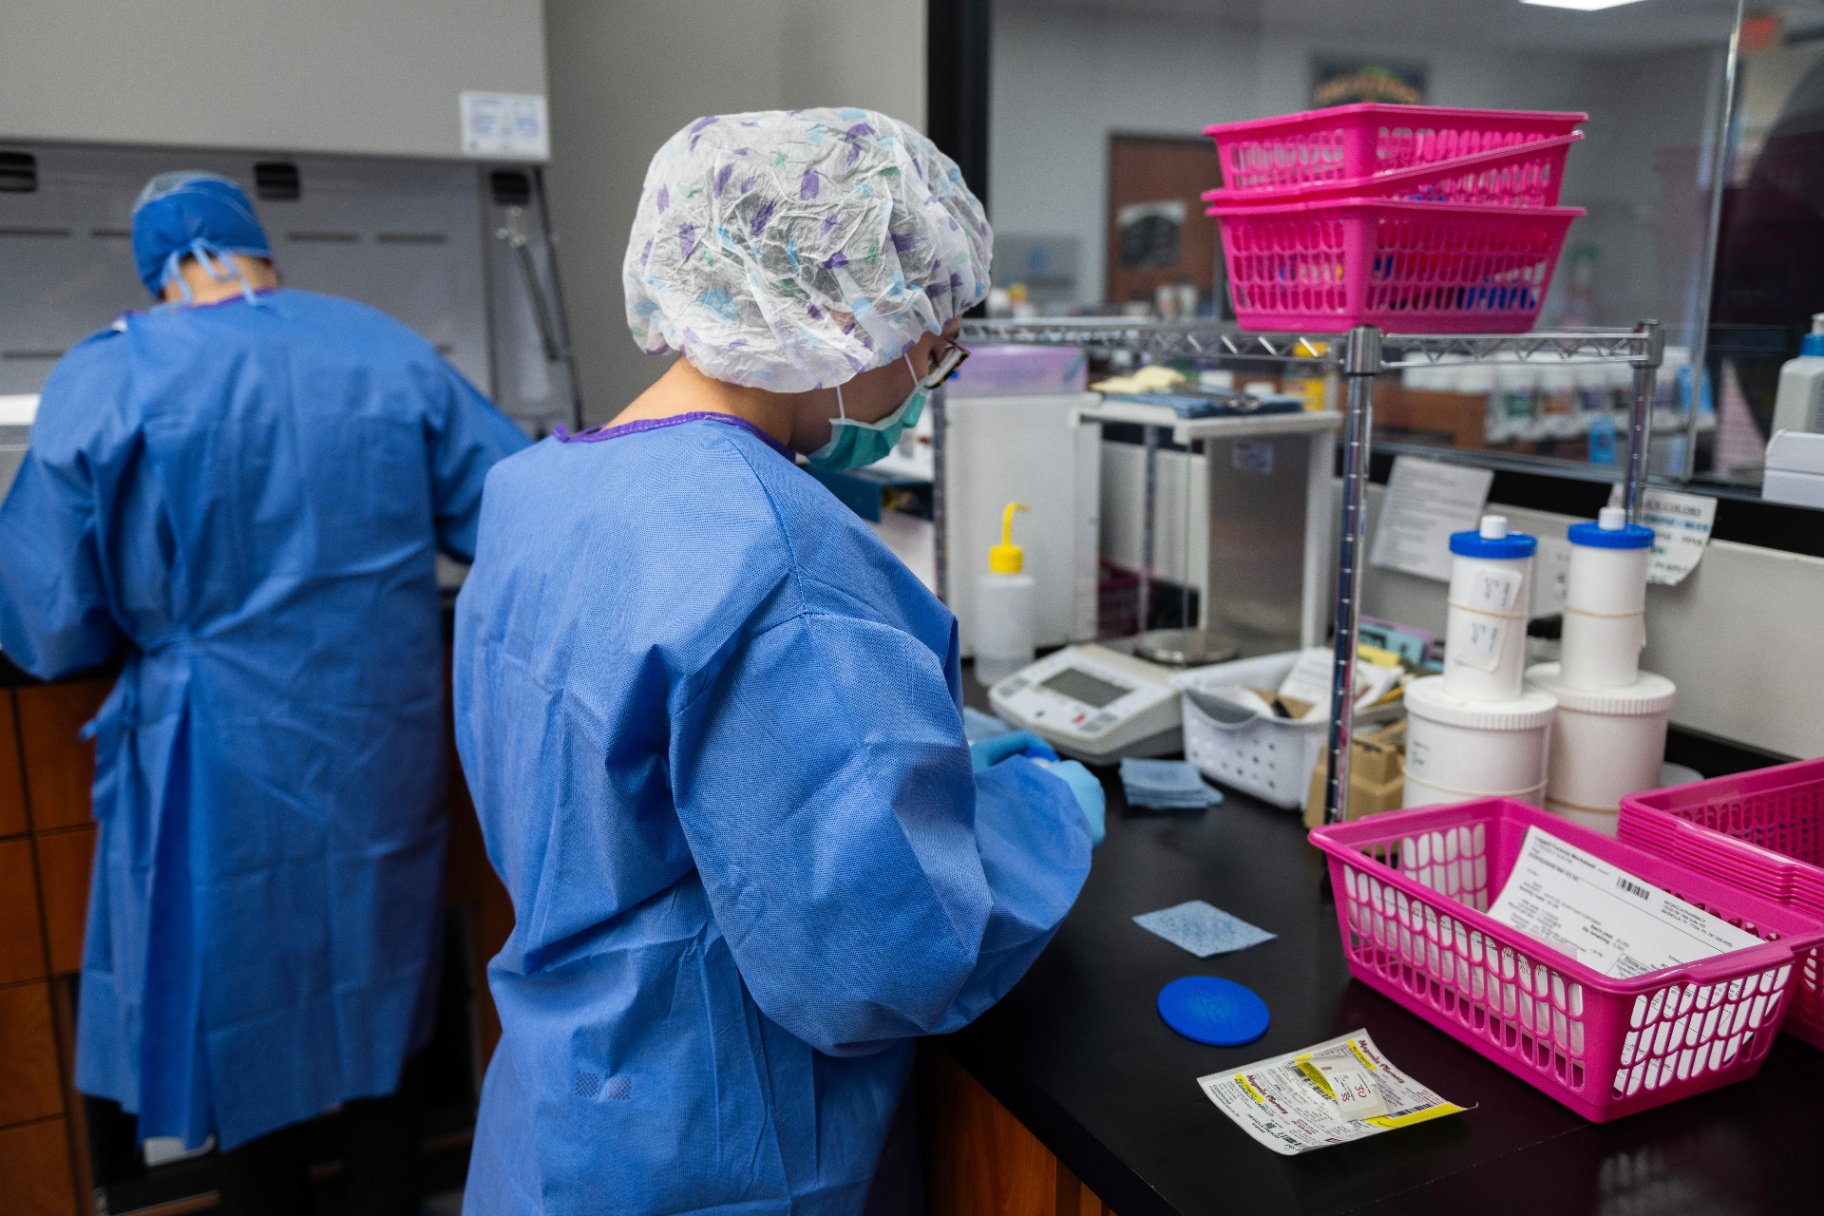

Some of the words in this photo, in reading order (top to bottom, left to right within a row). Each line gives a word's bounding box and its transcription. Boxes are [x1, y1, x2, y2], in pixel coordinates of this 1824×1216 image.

[1358, 1040, 1380, 1064] Magnolia
[1380, 1063, 1405, 1084] Pharmacy
[1246, 1074, 1267, 1095] Magnolia
[1266, 1094, 1288, 1114] Pharmacy
